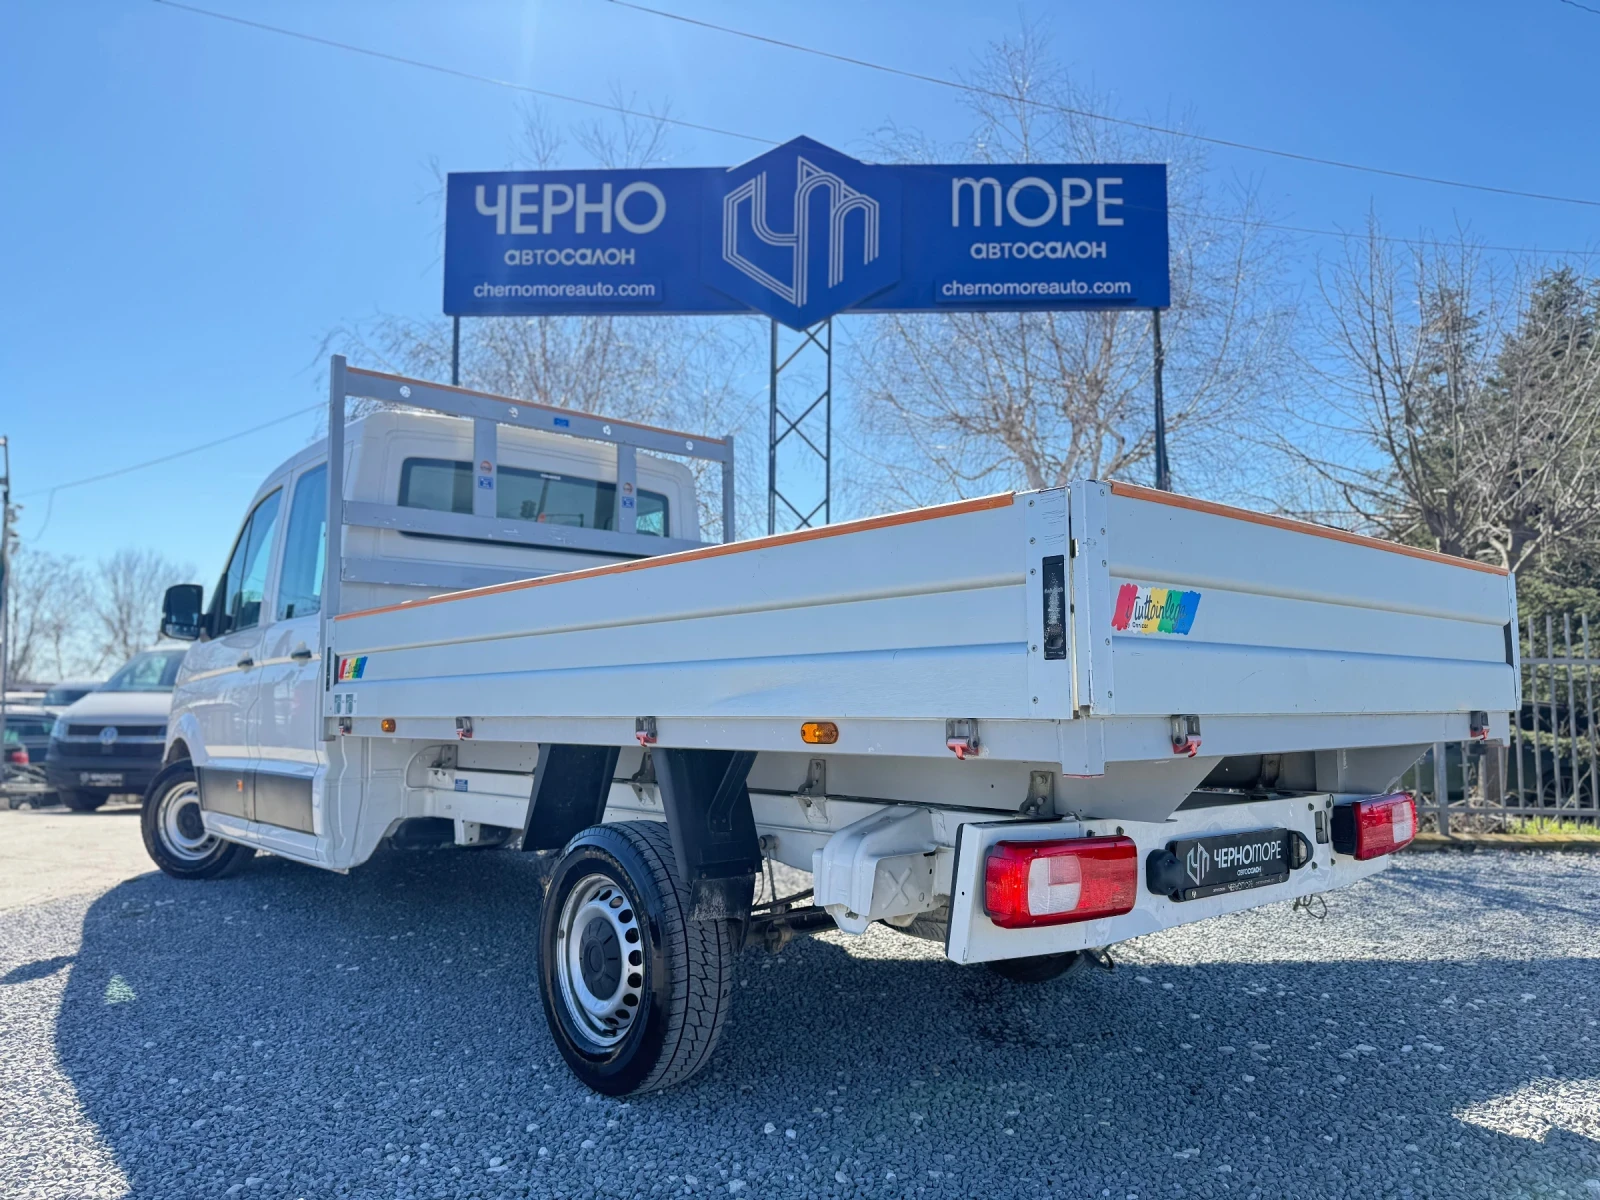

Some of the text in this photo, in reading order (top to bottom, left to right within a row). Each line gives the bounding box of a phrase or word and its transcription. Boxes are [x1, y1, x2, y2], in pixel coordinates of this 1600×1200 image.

[475, 181, 666, 235] ЧЕРНО
[504, 248, 635, 266] автосалон
[970, 241, 1107, 259] автосалон
[473, 281, 655, 298] chernomoreauto.com
[942, 280, 1131, 296] chernomoreauto.com
[1213, 840, 1282, 868] ЧЕРНОМОРЕ
